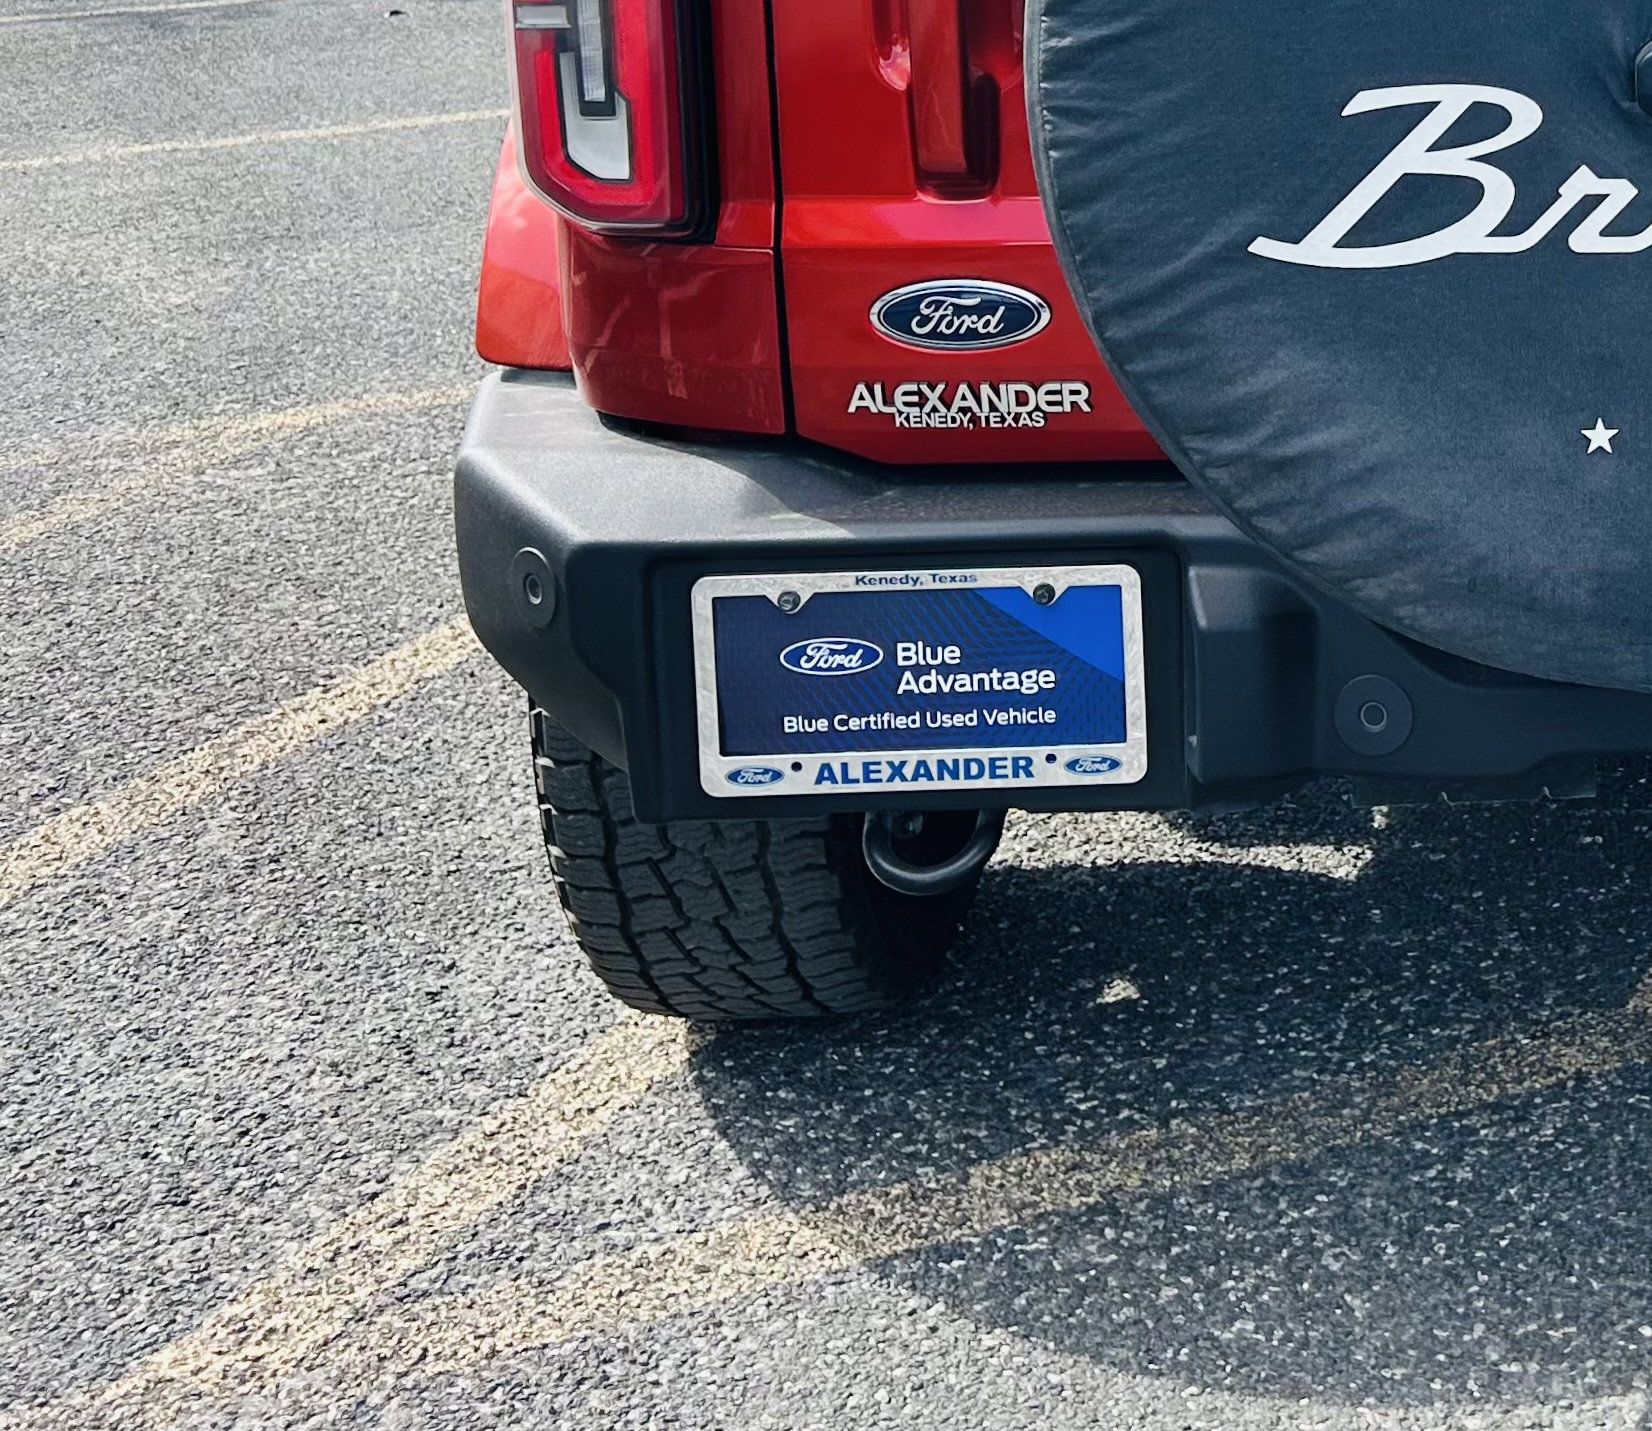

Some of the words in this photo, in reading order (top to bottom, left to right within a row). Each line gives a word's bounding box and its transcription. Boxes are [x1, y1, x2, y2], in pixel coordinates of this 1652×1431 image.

[911, 296, 1004, 334] Ford
[847, 382, 1091, 413] ALEXANDER
[895, 412, 974, 430] KENEDY,
[979, 412, 1045, 428] TEXAS
[855, 573, 923, 587] Kenedy,
[931, 572, 978, 584] Texas
[799, 643, 863, 669] Ford
[896, 640, 962, 666] Blue
[896, 667, 1057, 696] Advantage
[783, 715, 829, 733] Blue
[833, 711, 921, 732] Certified
[926, 709, 978, 728] Used
[983, 705, 1057, 726] Vehicle
[736, 768, 773, 784] Ford
[813, 755, 1035, 785] ALEXANDER
[1075, 756, 1112, 774] Ford
